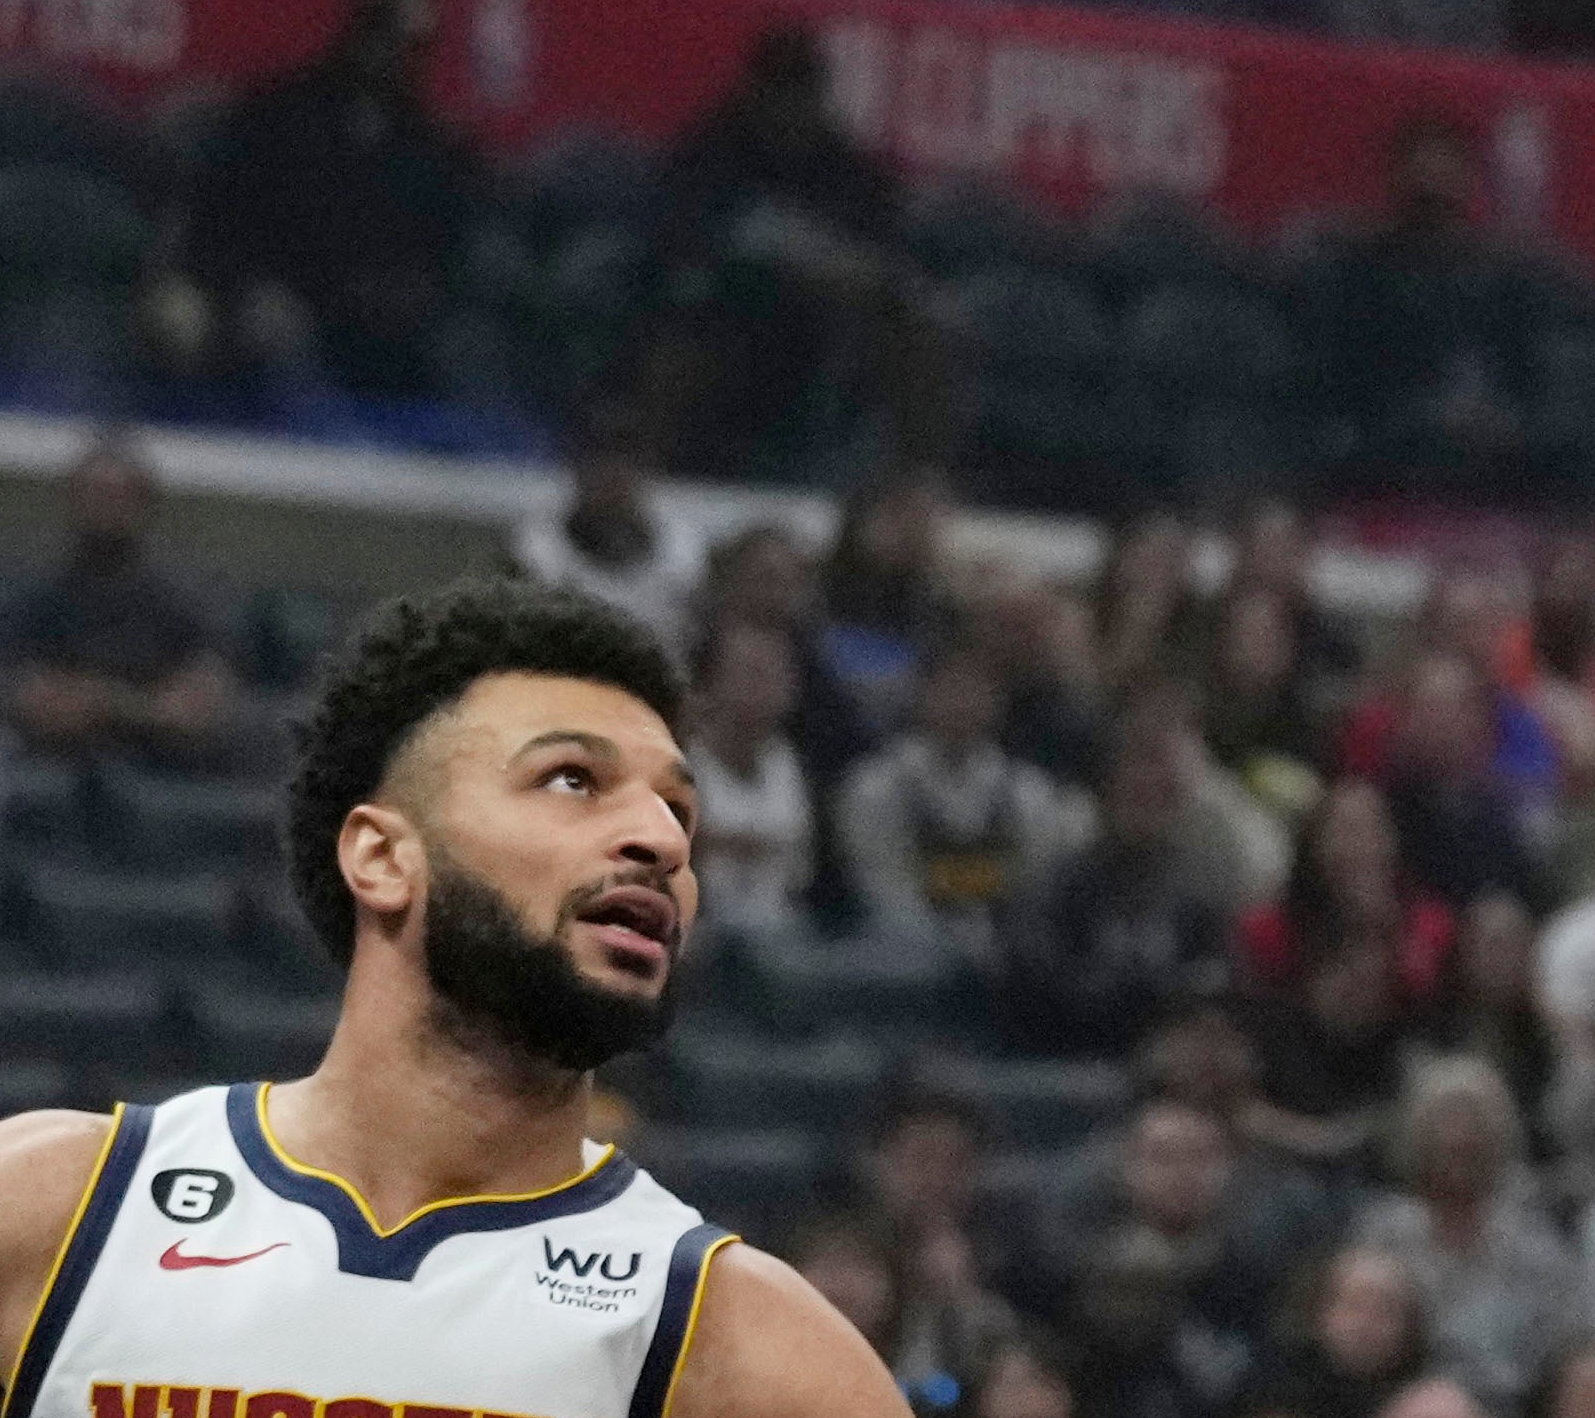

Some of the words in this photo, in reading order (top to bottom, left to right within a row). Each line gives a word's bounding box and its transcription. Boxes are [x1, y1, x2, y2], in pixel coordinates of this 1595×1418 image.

[167, 1176, 218, 1214] 6
[543, 1234, 643, 1282] WU
[534, 1271, 637, 1299] Western
[549, 1291, 619, 1313] Union
